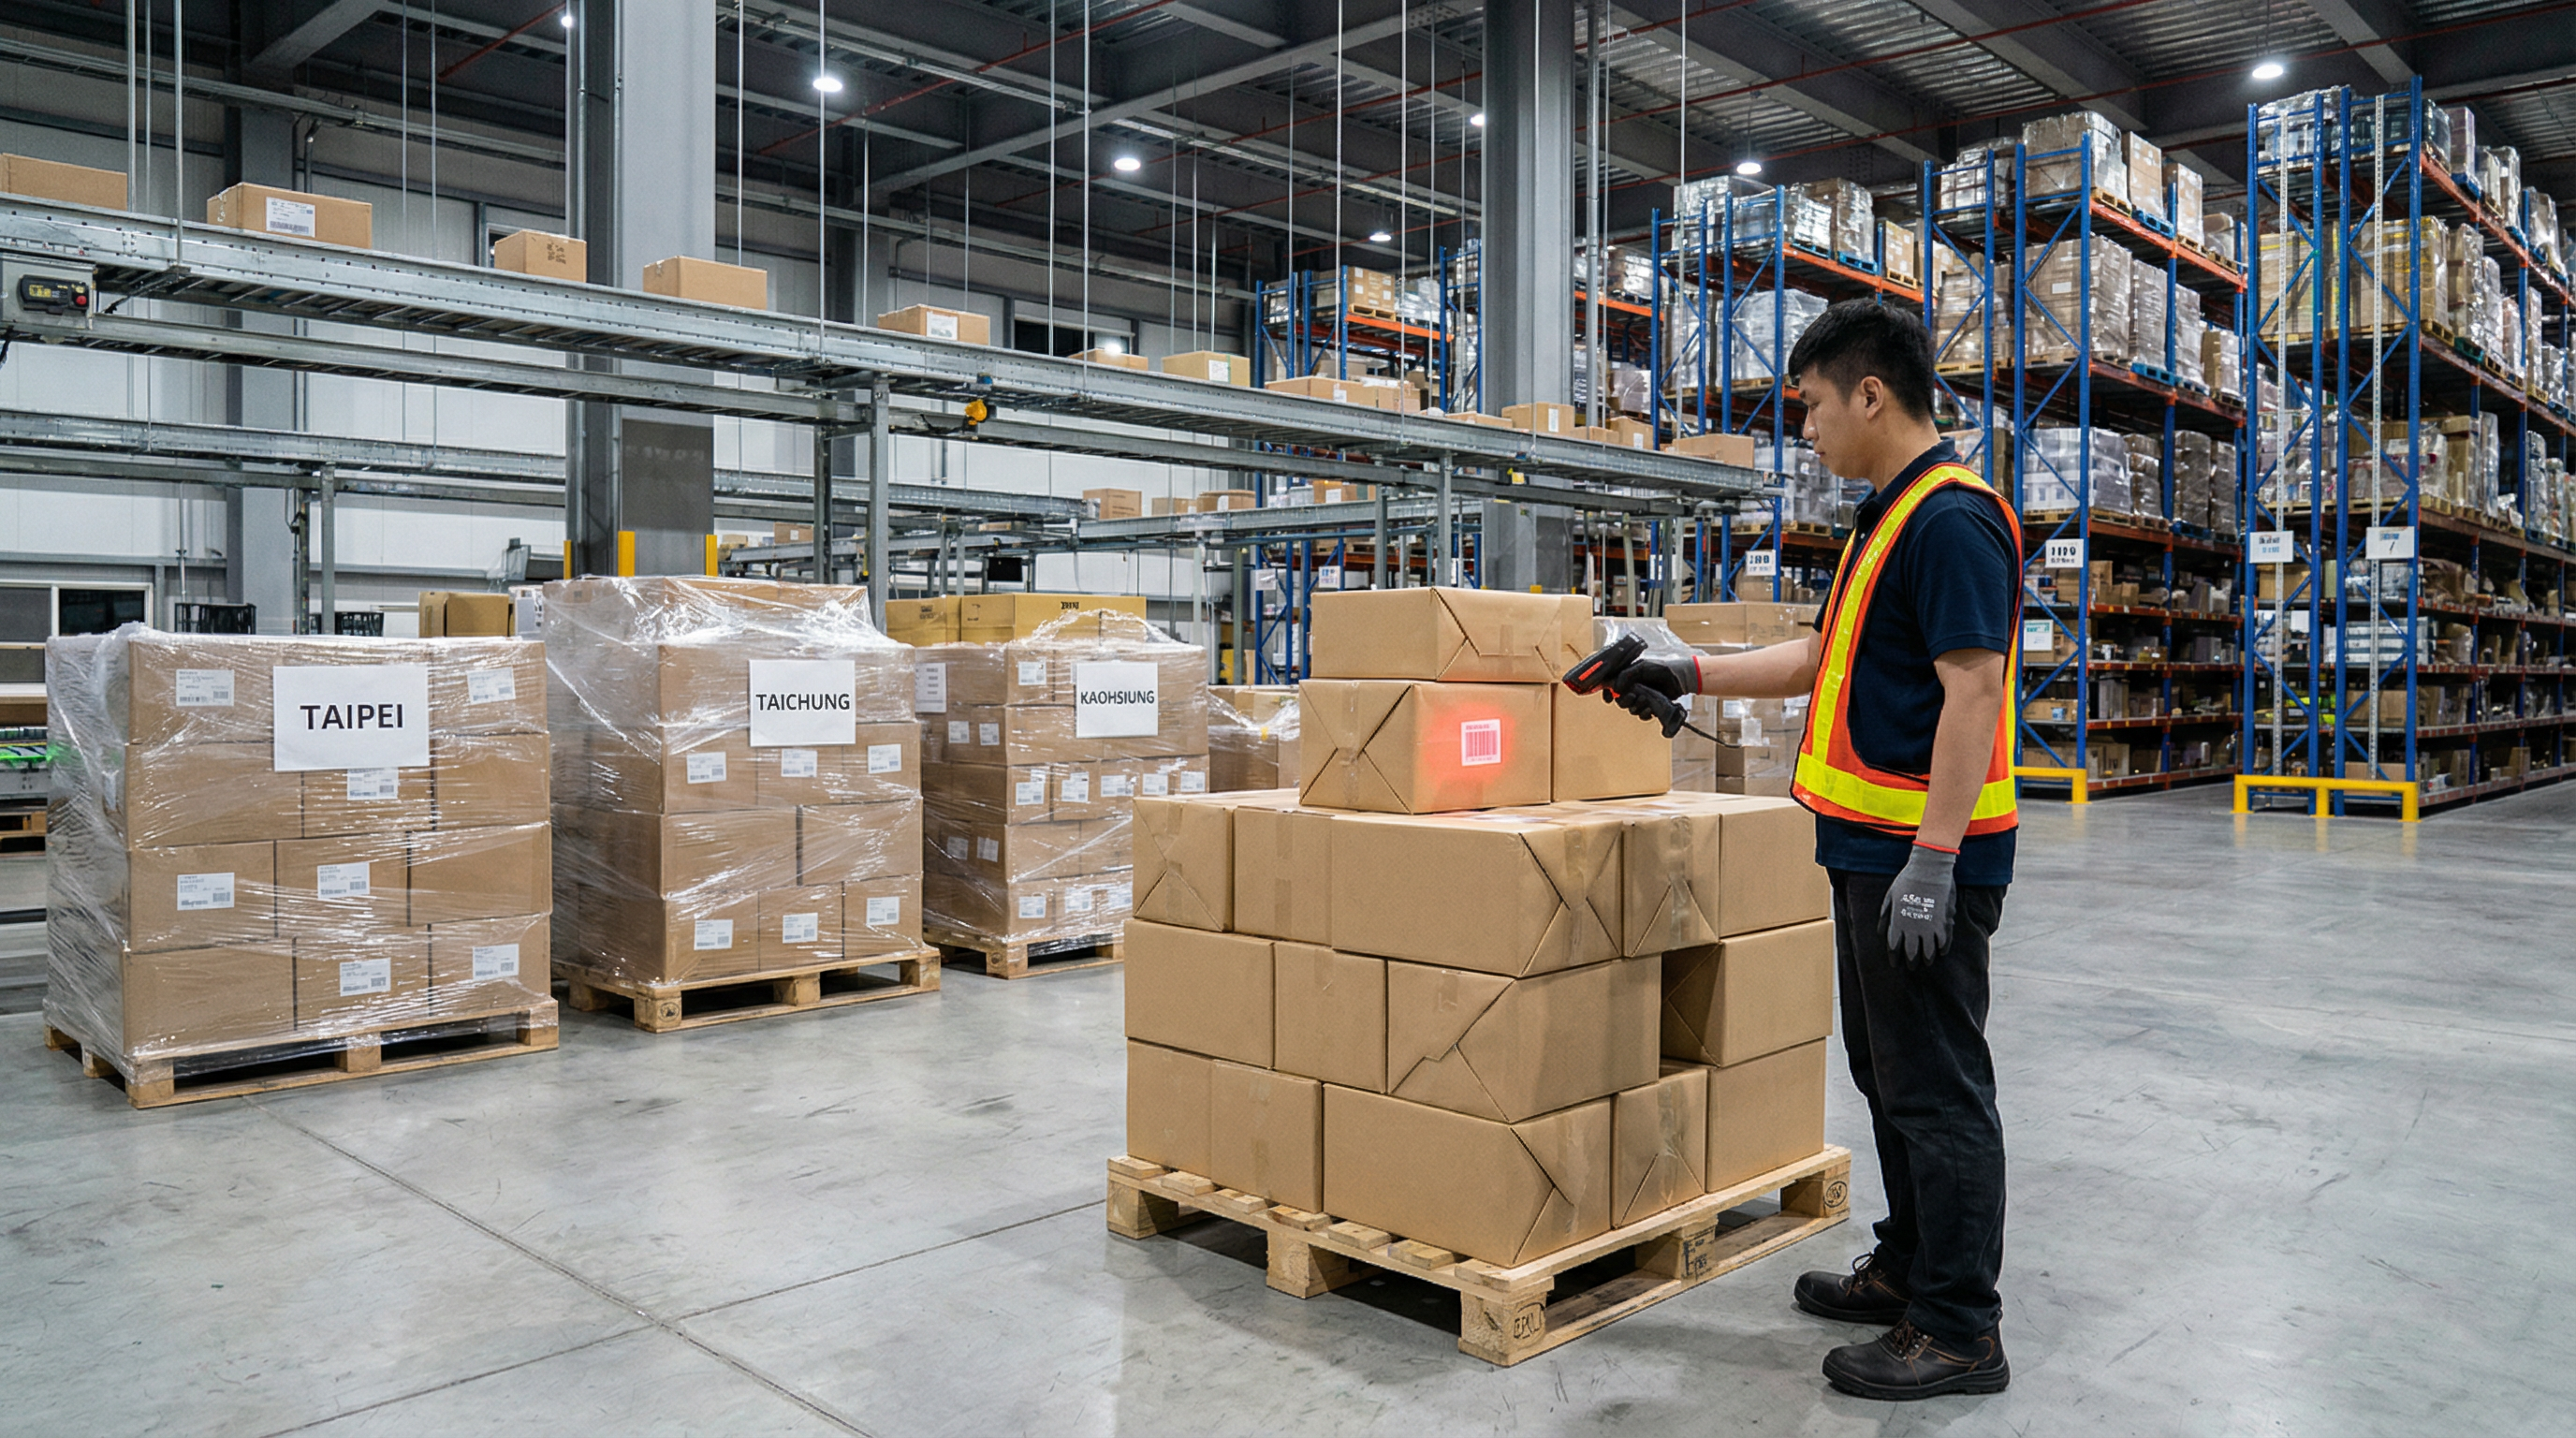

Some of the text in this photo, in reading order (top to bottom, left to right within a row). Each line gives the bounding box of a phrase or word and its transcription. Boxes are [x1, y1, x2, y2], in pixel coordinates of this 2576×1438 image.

[755, 693, 850, 712] TAICHUNG
[1080, 690, 1155, 705] KAOHSIUNG
[300, 703, 403, 730] TAIPEI
